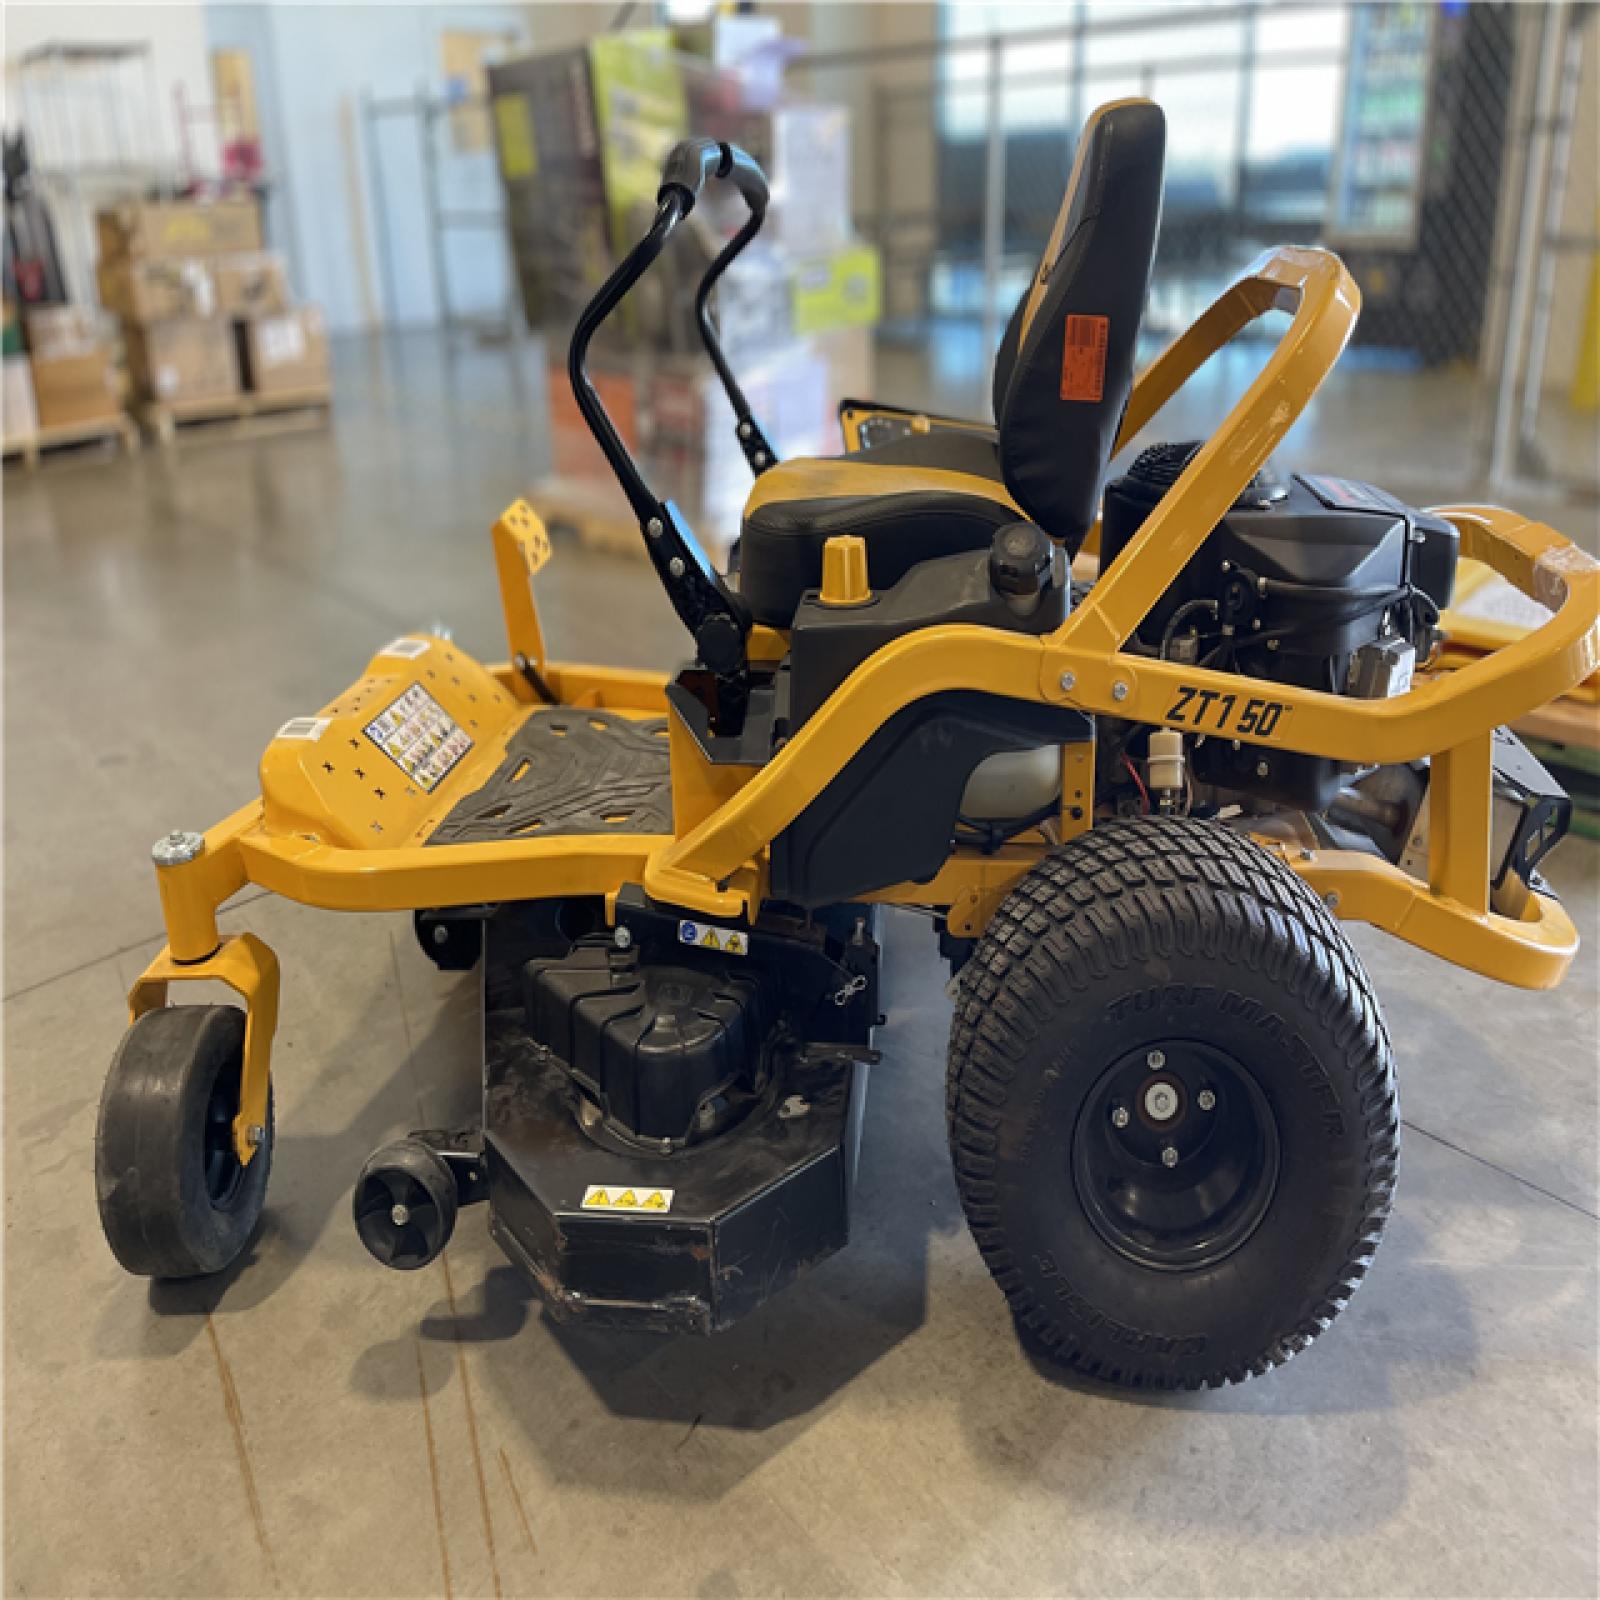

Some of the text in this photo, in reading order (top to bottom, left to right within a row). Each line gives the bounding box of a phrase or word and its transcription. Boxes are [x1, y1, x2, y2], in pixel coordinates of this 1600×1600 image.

[1166, 686, 1283, 736] ZT1 50
[1106, 984, 1216, 1024] TURF
